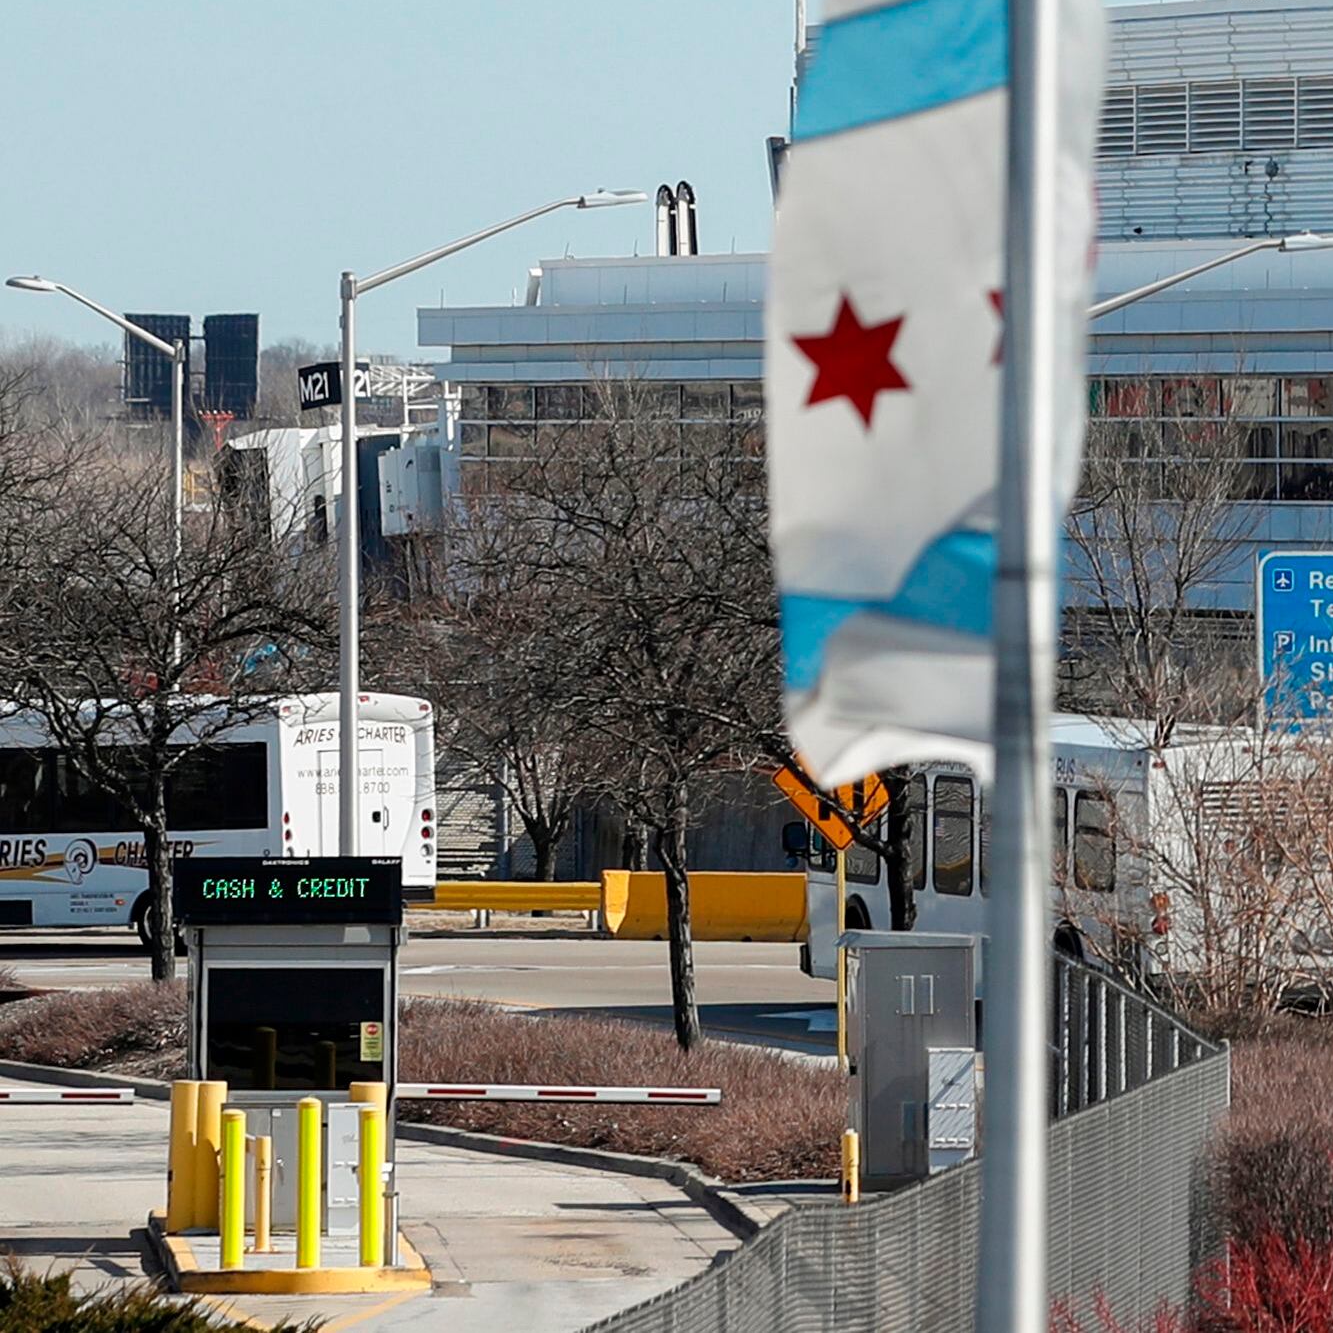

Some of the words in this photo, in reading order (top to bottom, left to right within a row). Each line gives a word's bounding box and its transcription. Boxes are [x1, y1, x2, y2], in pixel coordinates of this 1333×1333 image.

[300, 372, 329, 403] M21
[293, 728, 335, 747] ARIES
[358, 726, 407, 745] CHARTER
[1056, 757, 1076, 783] BUS
[0, 839, 48, 867] RIES
[114, 839, 195, 867] CHATER
[202, 878, 255, 899] CASH
[268, 878, 284, 899] &
[297, 878, 370, 898] CREDIT
